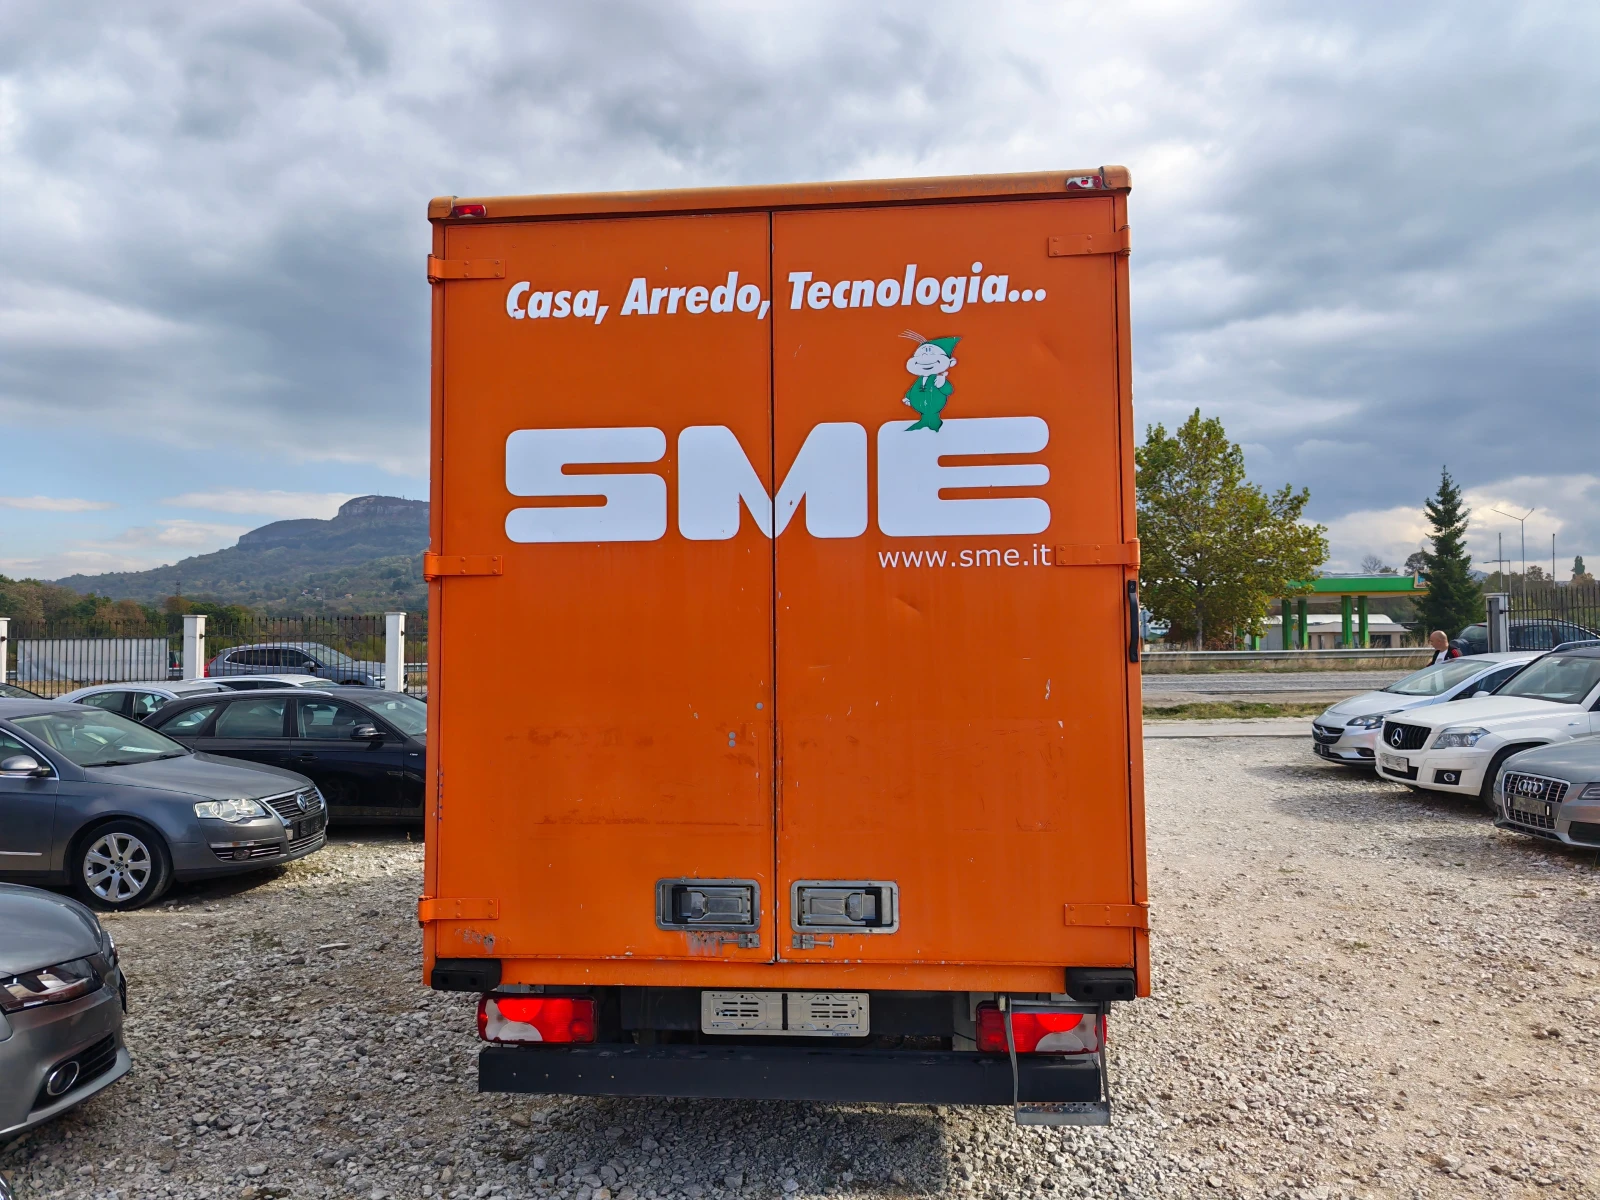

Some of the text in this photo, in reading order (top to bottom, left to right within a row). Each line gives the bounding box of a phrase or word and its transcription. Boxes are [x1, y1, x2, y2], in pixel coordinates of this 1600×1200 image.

[506, 261, 1047, 325] Casa, Arredo, Tecnologia...
[504, 415, 1052, 544] SME
[878, 544, 1052, 569] www.sme.it
